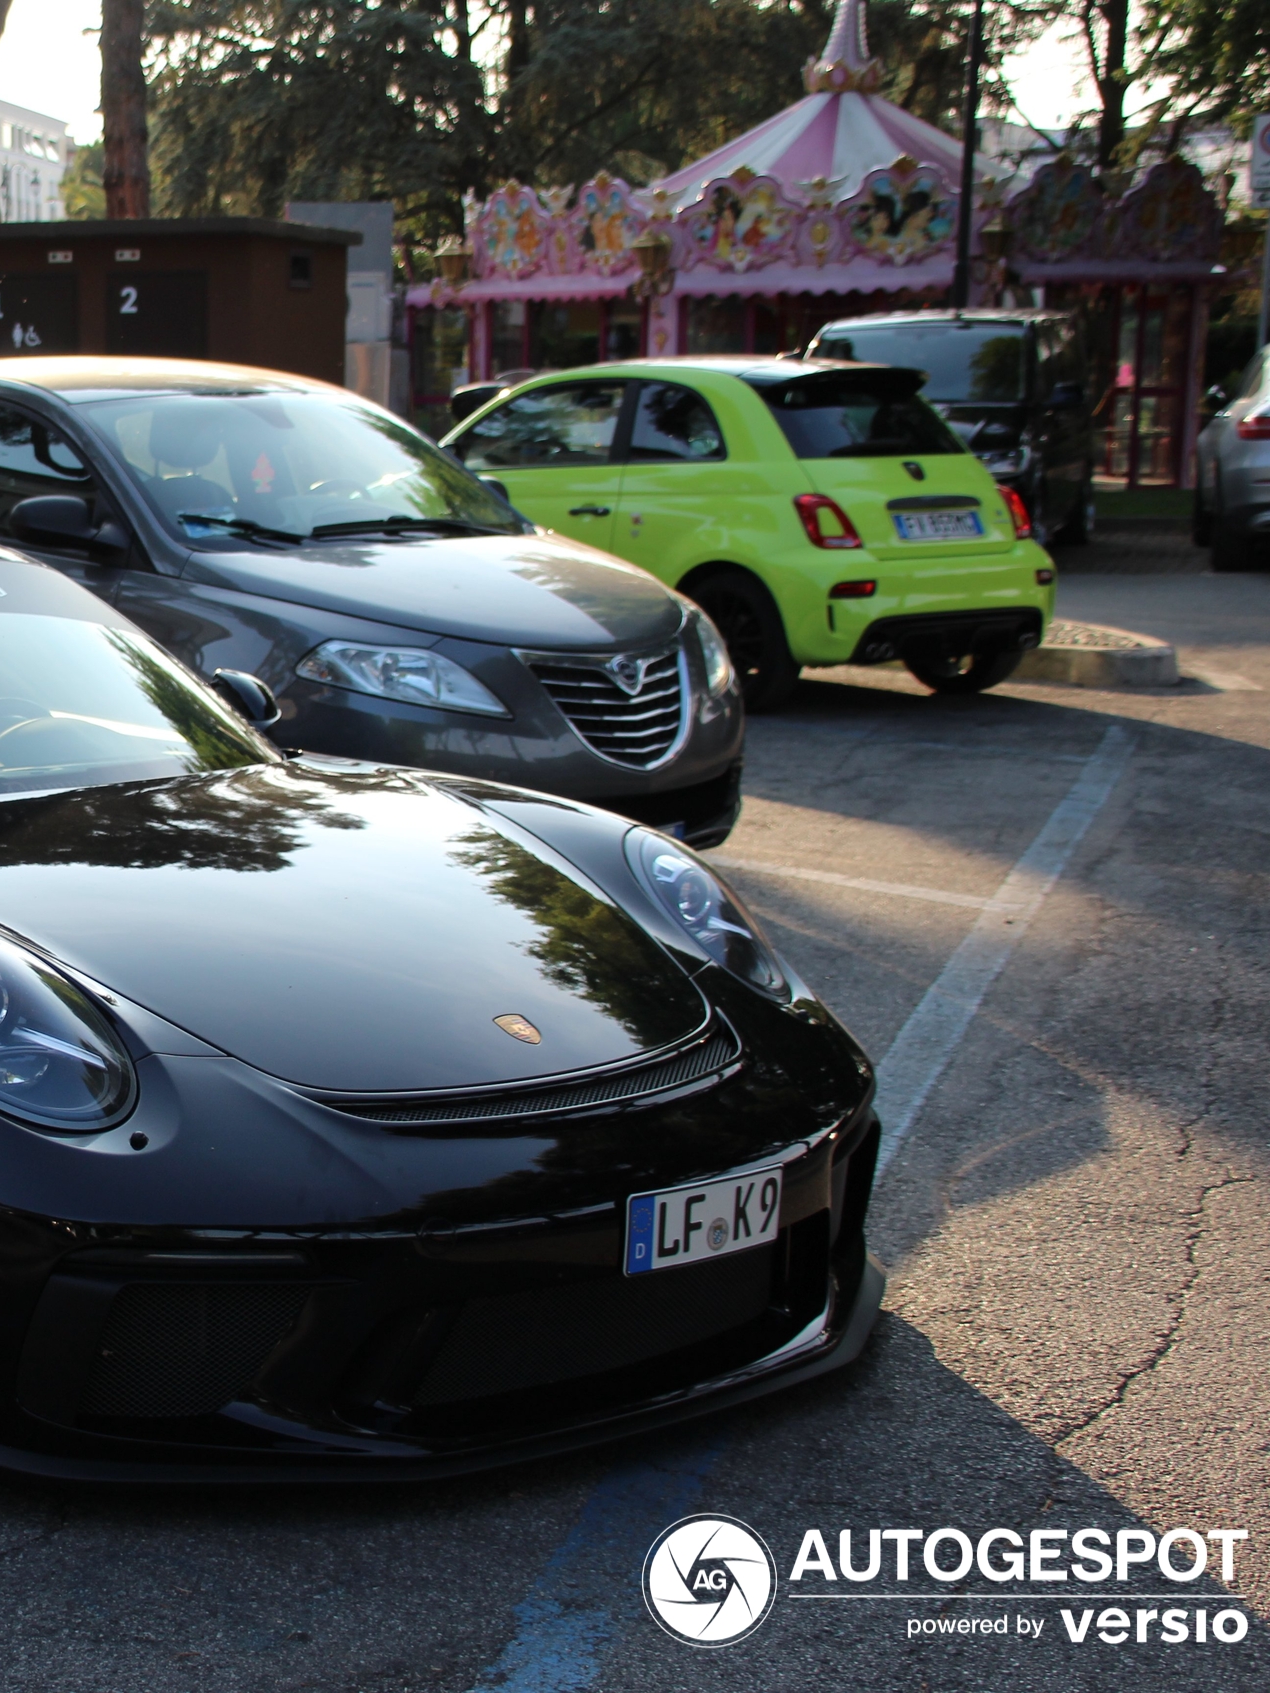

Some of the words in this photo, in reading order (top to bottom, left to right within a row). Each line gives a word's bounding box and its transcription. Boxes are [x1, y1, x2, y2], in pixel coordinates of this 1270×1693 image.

[119, 286, 138, 314] 2
[657, 1193, 706, 1258] LF
[733, 1176, 779, 1241] K9
[635, 1243, 646, 1259] D
